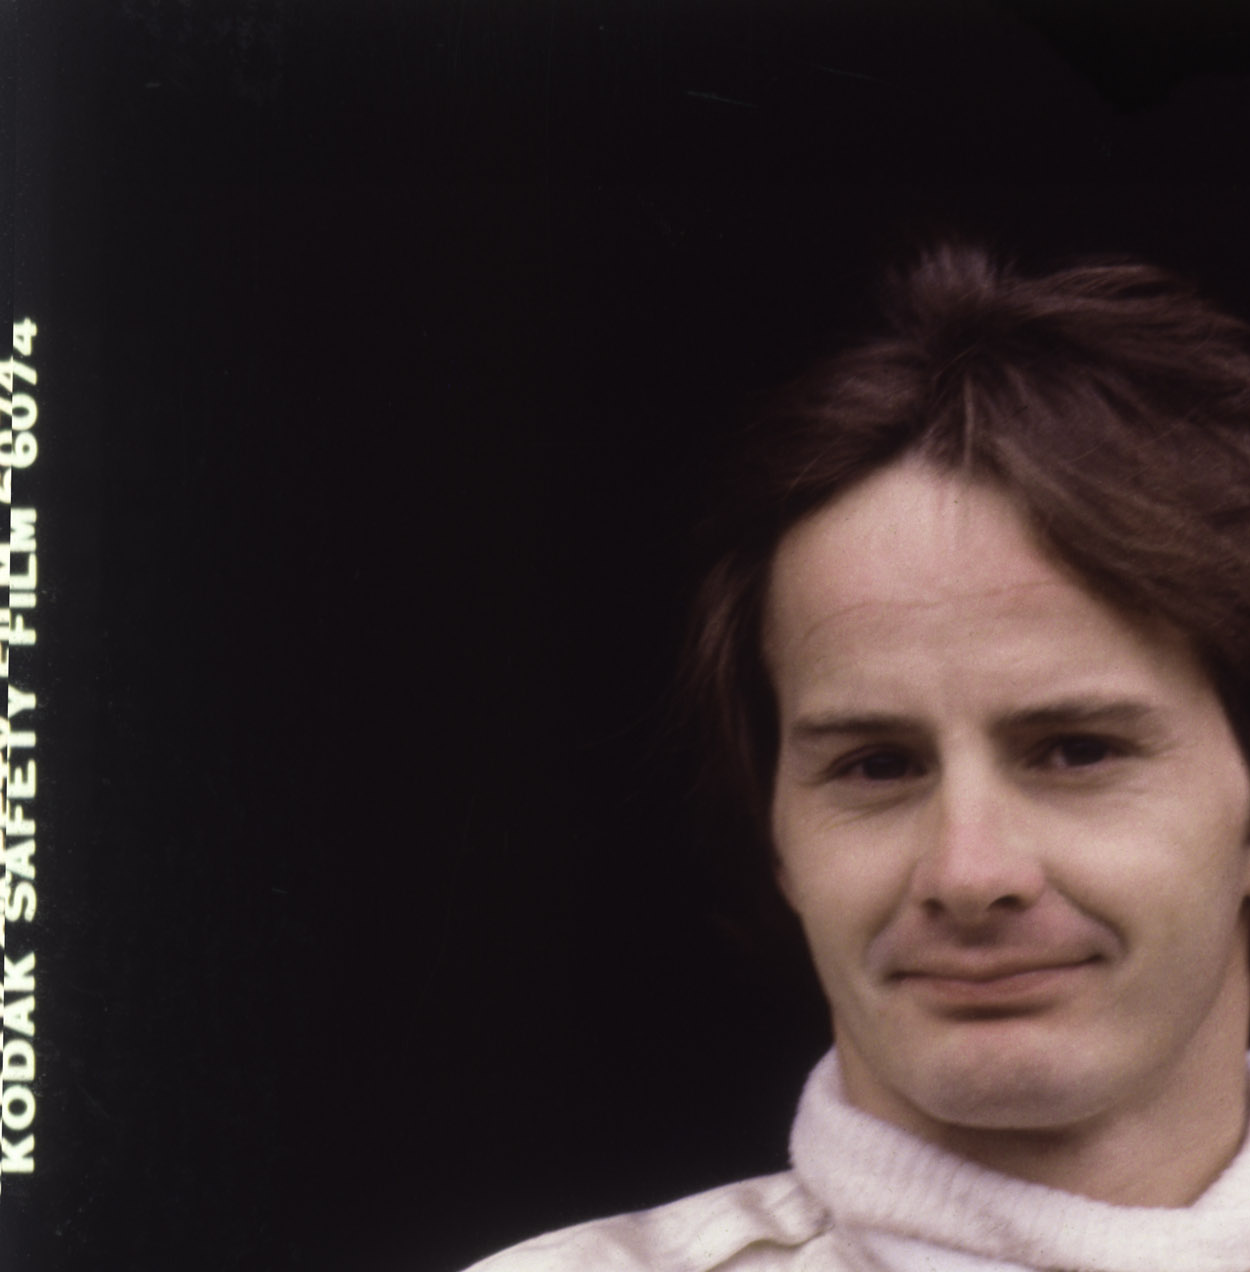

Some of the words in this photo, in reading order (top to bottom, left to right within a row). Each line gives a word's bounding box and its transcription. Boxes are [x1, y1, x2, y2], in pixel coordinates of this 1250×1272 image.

[12, 317, 38, 468] 6074
[9, 508, 37, 645] FILM
[5, 685, 37, 922] SAFETY
[2, 951, 36, 1173] KODAK
